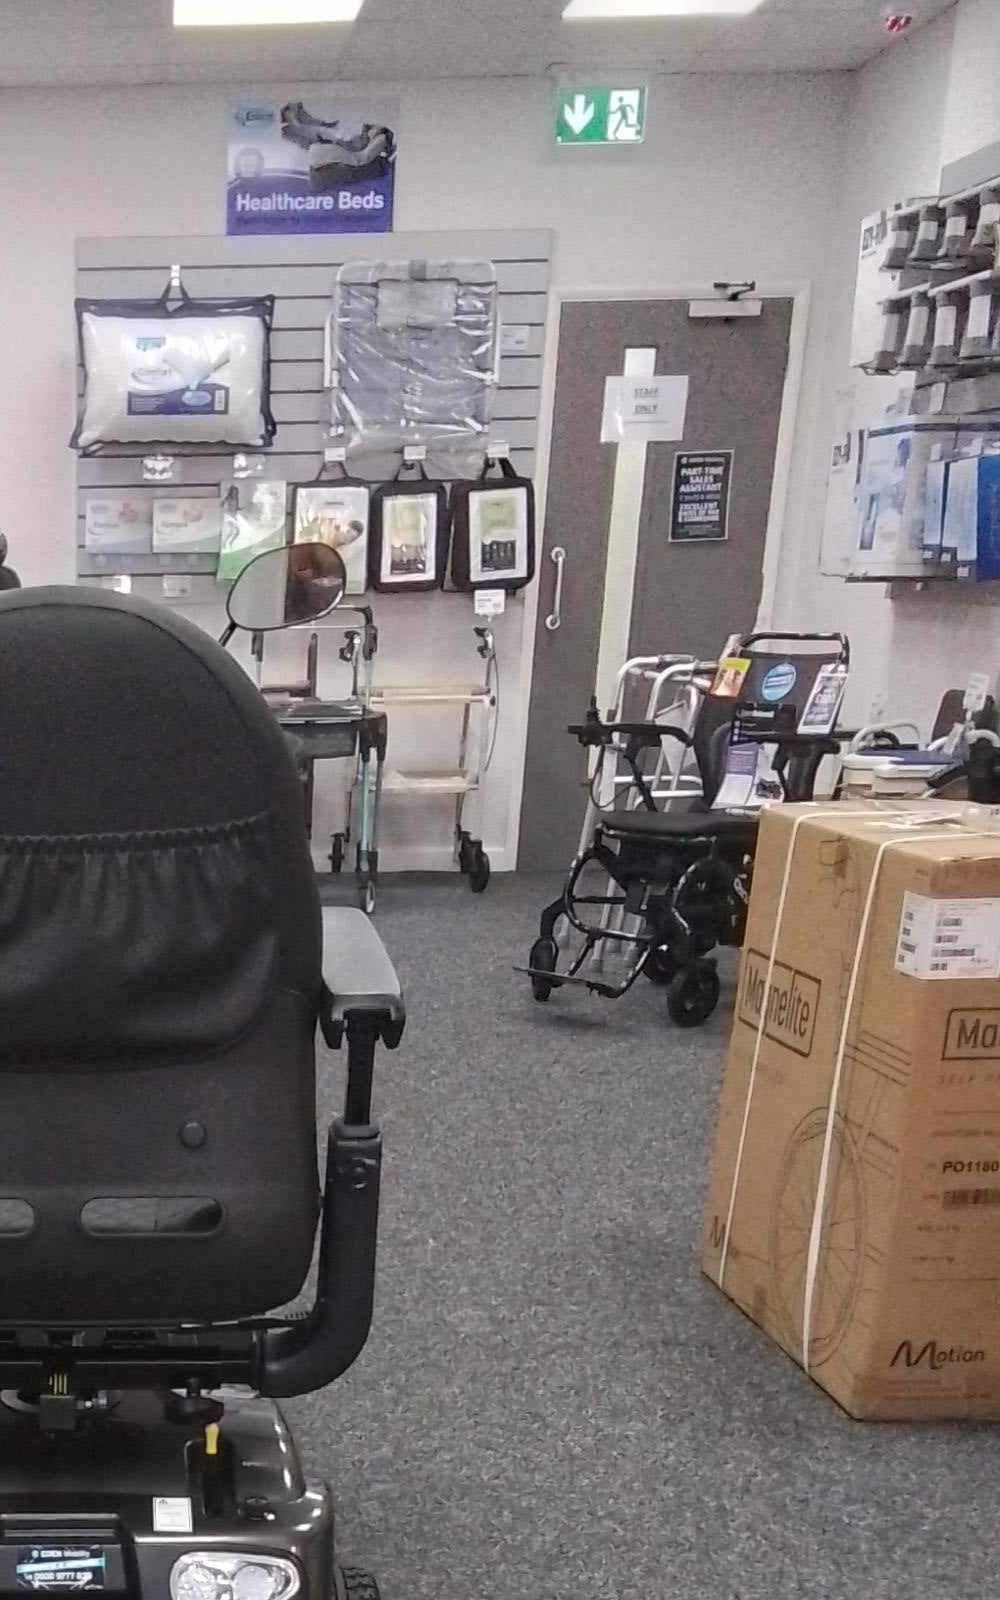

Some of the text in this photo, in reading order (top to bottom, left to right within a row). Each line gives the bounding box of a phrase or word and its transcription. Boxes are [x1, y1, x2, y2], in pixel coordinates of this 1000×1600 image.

[236, 191, 385, 211] Healthcare Beds
[634, 403, 658, 414] ONLY
[679, 482, 722, 492] ASSISTANT
[744, 965, 811, 1038] Manelite
[889, 1340, 985, 1370] Motion
